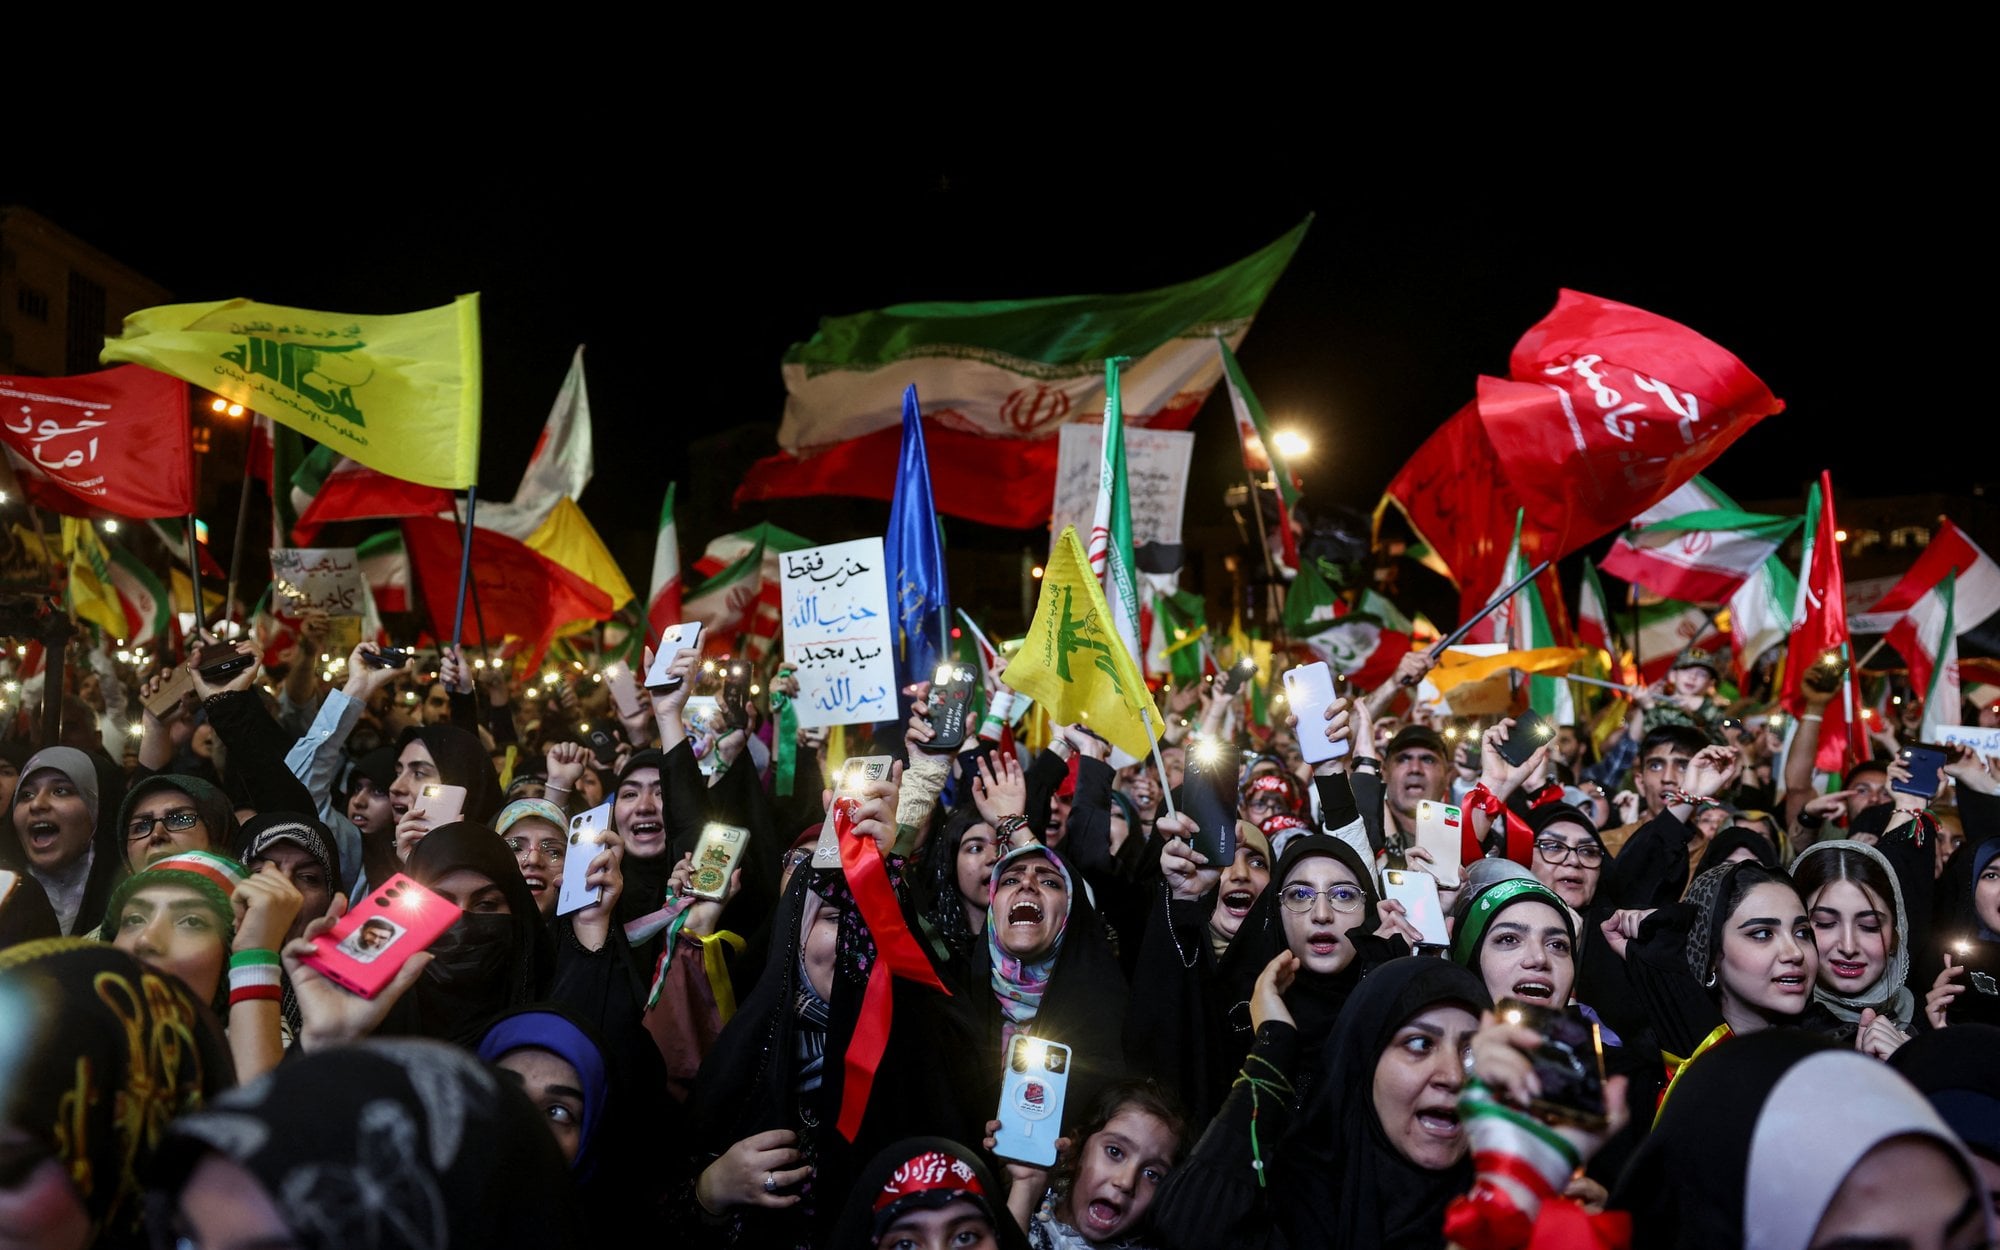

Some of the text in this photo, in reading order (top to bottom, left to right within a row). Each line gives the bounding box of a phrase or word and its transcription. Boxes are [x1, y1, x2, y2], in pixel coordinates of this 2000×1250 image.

[787, 551, 870, 591] حزب فقط
[818, 603, 878, 634] حزب
[798, 646, 882, 670] سید مجید
[942, 707, 954, 738] MINNIE
[952, 702, 964, 733] MICKEY
